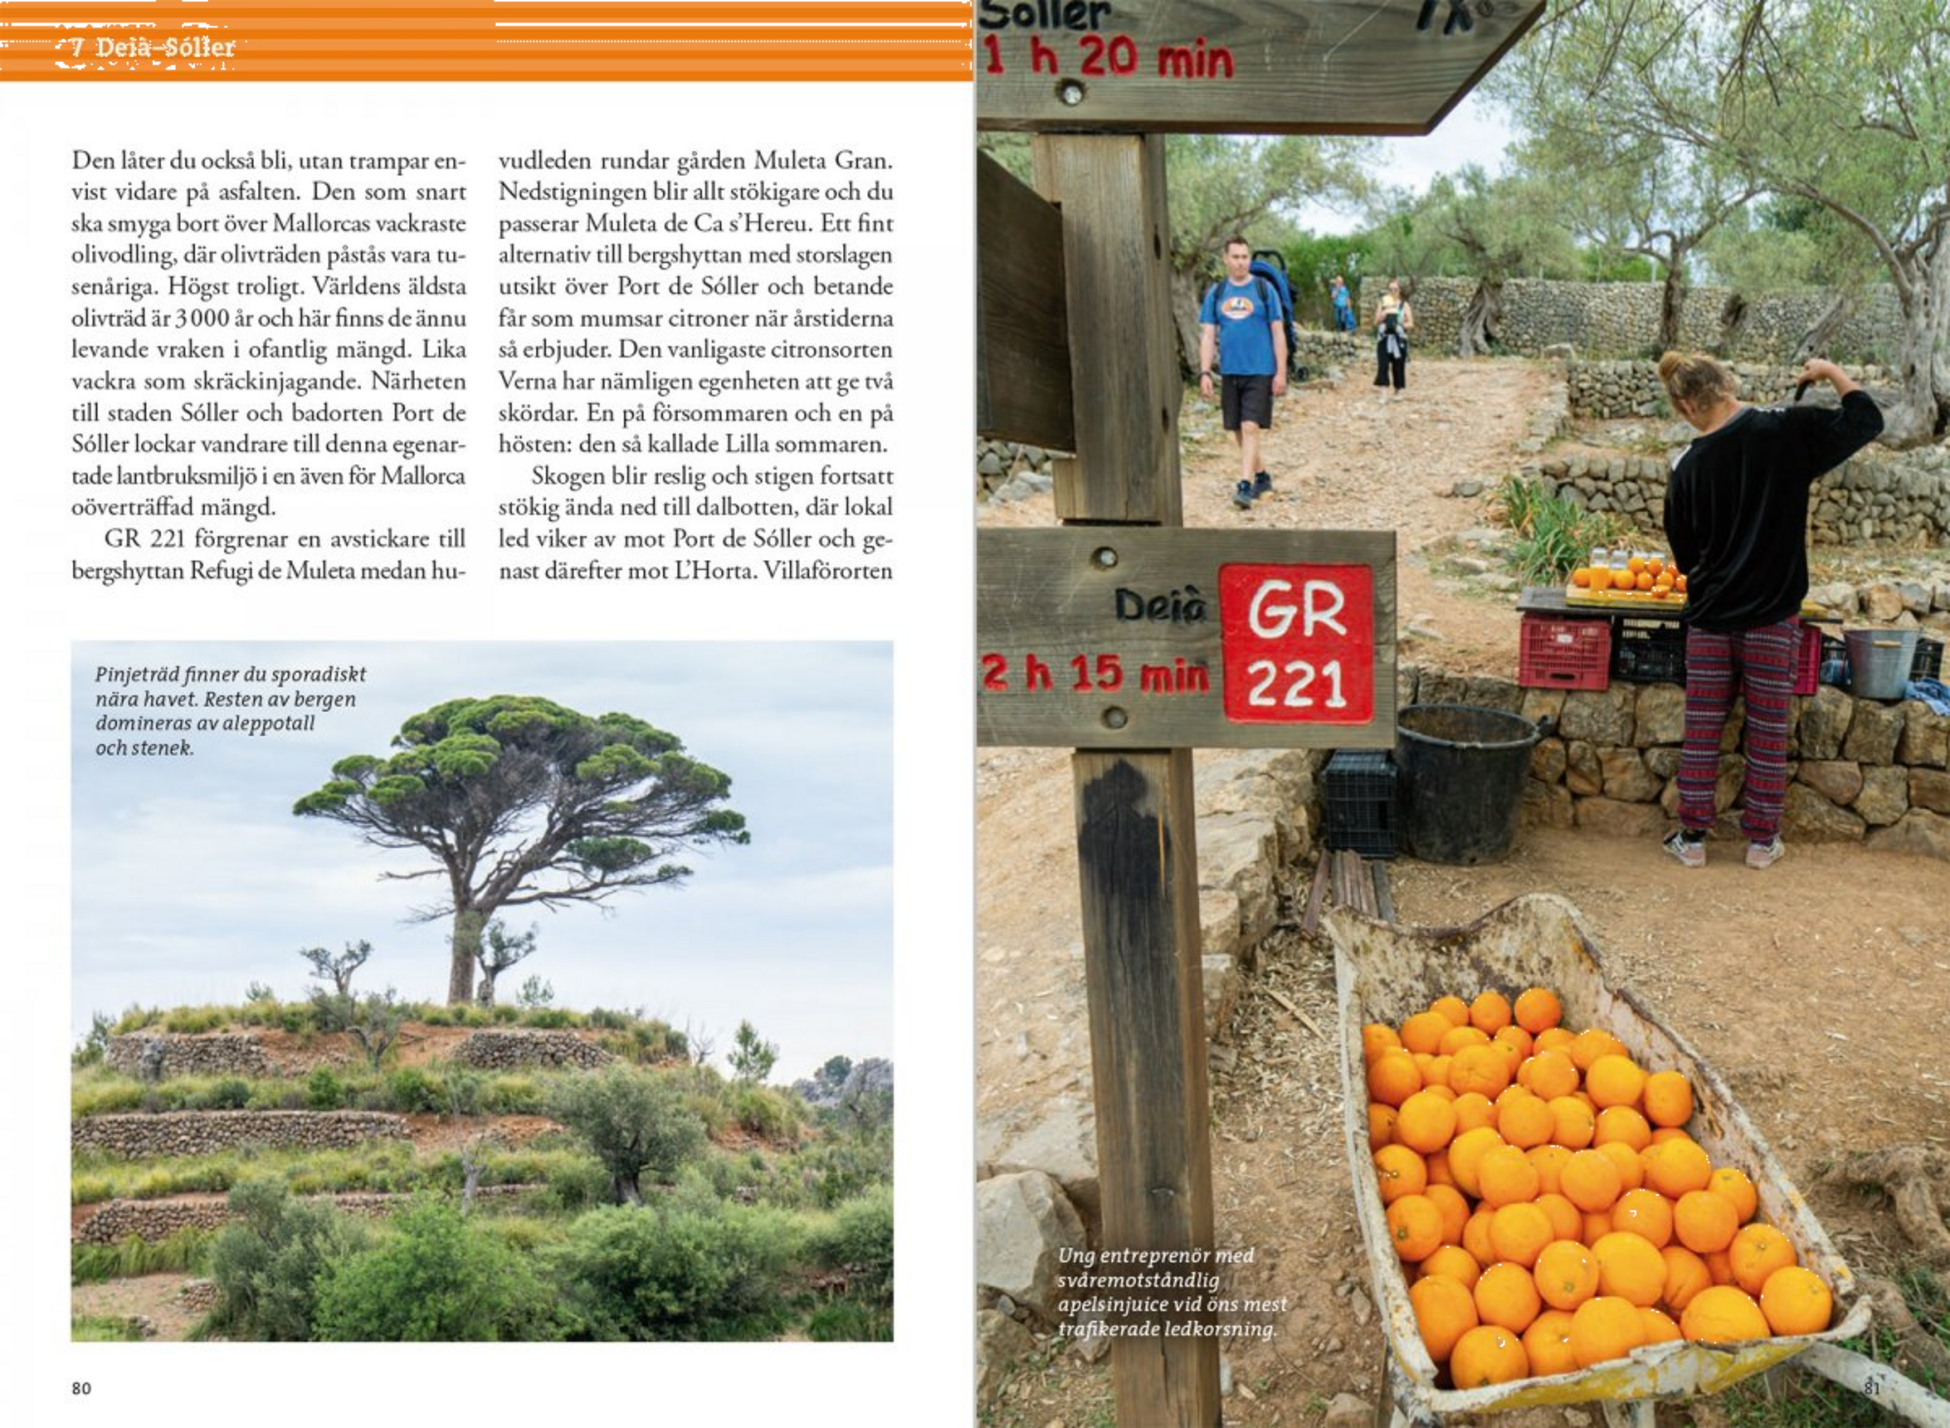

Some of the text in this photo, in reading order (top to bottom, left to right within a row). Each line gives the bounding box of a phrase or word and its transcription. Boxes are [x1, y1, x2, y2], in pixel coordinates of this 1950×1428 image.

[70, 37, 84, 57] 7
[983, 35, 1235, 80] 1 h 20 min
[73, 149, 115, 170] Den
[121, 149, 166, 170] låter
[169, 149, 196, 170] du
[201, 149, 256, 170] också
[261, 149, 293, 171] bli,
[299, 155, 343, 170] utan
[349, 155, 430, 177] trampar
[498, 149, 893, 177] vudleden rundar gården Muleta Gran.
[499, 180, 894, 208] Nedstigningen blir allt stökigare och du
[71, 212, 467, 240] ska smyga bort över Mallorcas vackraste
[499, 219, 580, 240] passerar
[586, 212, 657, 233] Muleta
[663, 212, 688, 233] de
[694, 212, 724, 233] Ca
[821, 212, 851, 233] Ett
[858, 211, 894, 233] fint
[71, 243, 178, 271] olivodling,
[183, 243, 217, 264] där
[220, 243, 321, 264] olivträden
[327, 244, 386, 271] påstås
[390, 250, 431, 264] vara
[499, 243, 892, 271] alternativ till bergshyttan med storslagen
[71, 275, 467, 303] senåriga. Högst troligt. Världens äldsta
[499, 306, 894, 328] får som mumsar citroner när årstiderna
[72, 337, 467, 365] levande vraken i ofantlig mängd. Lika
[498, 337, 893, 365] så erbjuder. Den vanligaste citronsorten
[72, 369, 466, 398] vackra som skräckinjagande. Närheten
[72, 432, 130, 453] Sóller
[134, 432, 196, 453] lockar
[201, 432, 288, 453] vandrare
[293, 432, 320, 453] till
[325, 432, 388, 453] denna
[499, 432, 888, 453] hösten: den så kallade Lilla sommaren.
[532, 464, 894, 492] Skogen blir reslig och stigen fortsatt
[71, 495, 276, 523] oöverträffad mängd.
[498, 495, 893, 523] stökig ända ned till dalbotten, där lokal
[104, 527, 466, 555] GR 221 förgrenar en avstickare till
[72, 559, 185, 587] bergshyttan
[190, 559, 254, 587] Refugi
[257, 559, 282, 580] de
[286, 559, 356, 580] Muleta
[360, 559, 427, 580] medan
[499, 566, 539, 580] nast
[544, 559, 623, 580] därefter
[628, 566, 669, 580] mot
[763, 559, 893, 580] Villaförorten
[1115, 584, 1209, 624] Deià
[1247, 578, 1347, 639] GR
[981, 652, 1210, 696] 2 h 15 min
[1247, 659, 1347, 708] 221
[71, 1381, 92, 1396] 80
